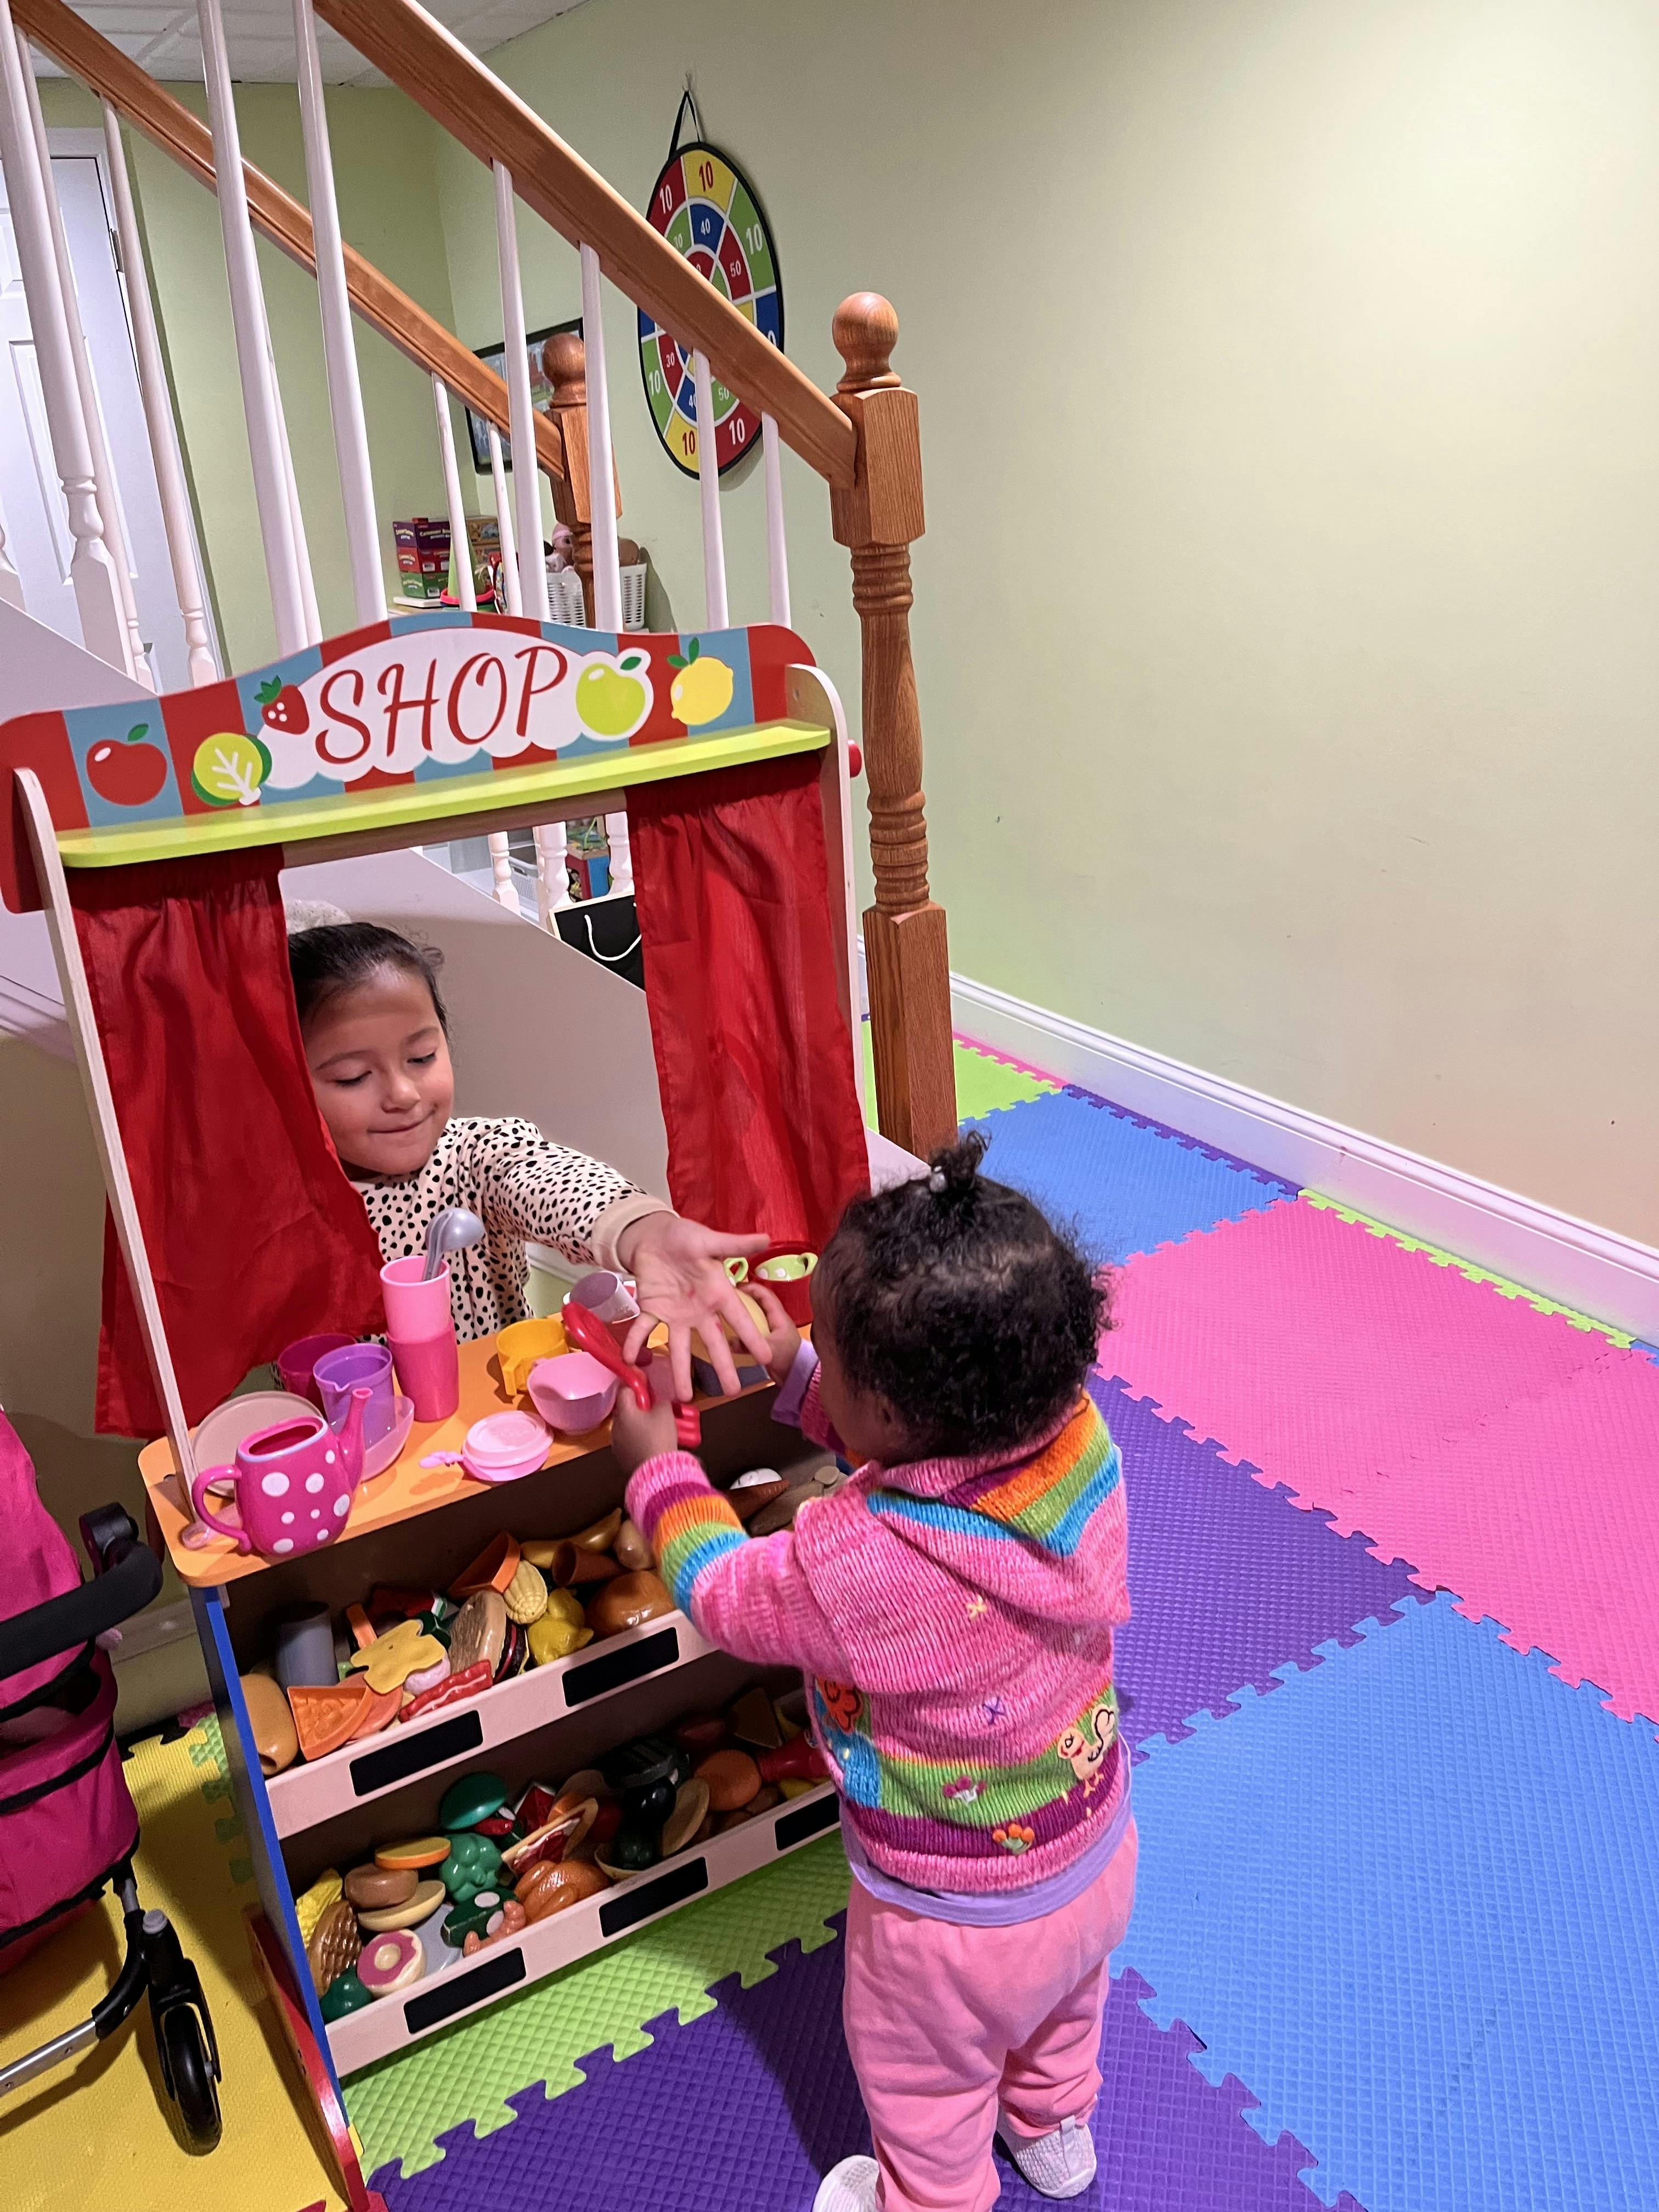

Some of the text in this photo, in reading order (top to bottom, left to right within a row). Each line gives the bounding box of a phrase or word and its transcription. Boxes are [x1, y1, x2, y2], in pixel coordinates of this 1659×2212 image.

[699, 161, 714, 192] 10
[659, 184, 673, 214] 10
[701, 218, 710, 235] 40
[746, 223, 763, 255] 10
[730, 260, 741, 277] 50
[666, 352, 675, 368] 30
[649, 370, 661, 396] 10
[718, 387, 730, 401] 50
[682, 430, 696, 456] 10
[729, 418, 745, 445] 10
[315, 645, 568, 765] SHOP
